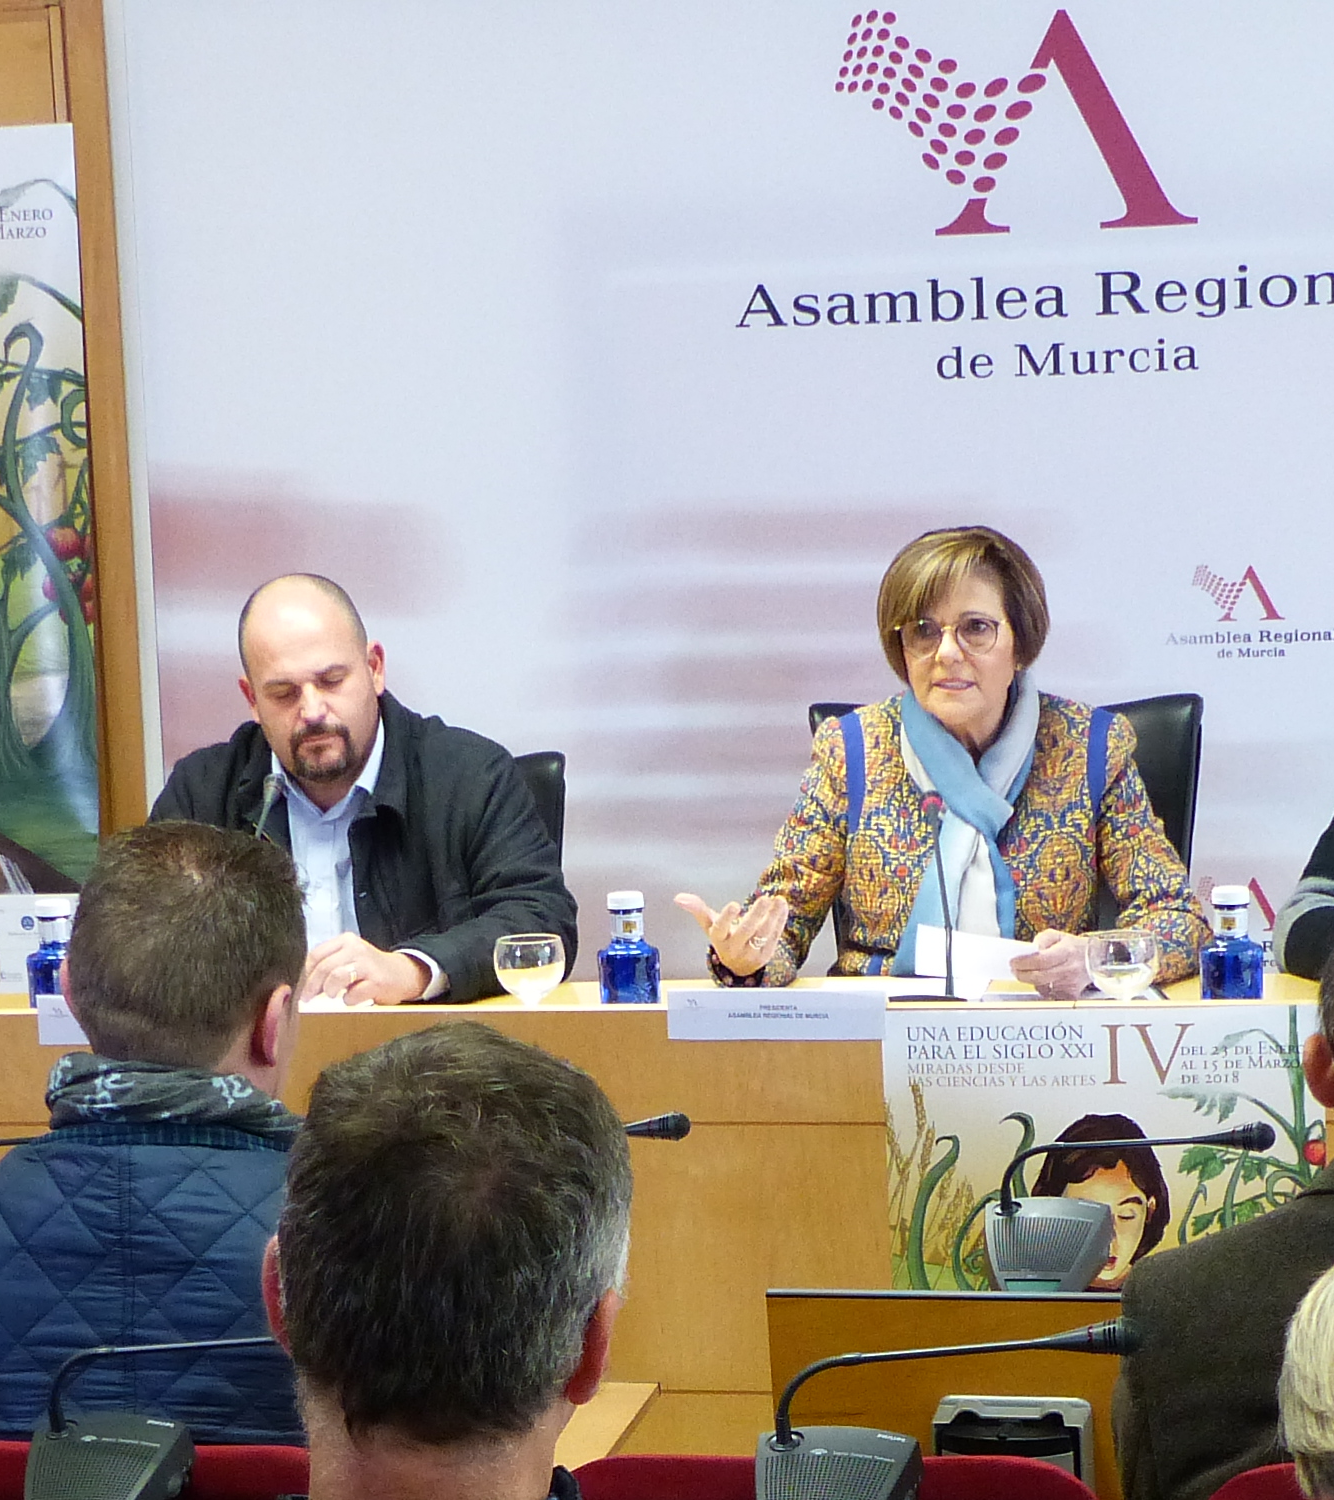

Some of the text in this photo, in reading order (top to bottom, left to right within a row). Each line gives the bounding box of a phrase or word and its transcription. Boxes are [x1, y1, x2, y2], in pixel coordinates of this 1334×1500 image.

[736, 277, 1069, 328] Asamblea
[936, 338, 1199, 379] de Murcia
[1166, 631, 1252, 646] Asamblea
[1217, 646, 1286, 659] de Murcia
[907, 1021, 1084, 1042] UNA EDUCACIÓN
[907, 1042, 1095, 1060] PARA EL SIGLO XXI
[1100, 1023, 1195, 1086] IV
[1210, 1046, 1229, 1058] 23
[907, 1062, 1025, 1075] MIRADAS DESDE
[1203, 1060, 1218, 1072] 15
[908, 1074, 1097, 1088] LAS CIENCIAS Y LAS ARTES
[1205, 1071, 1240, 1084] 2018
